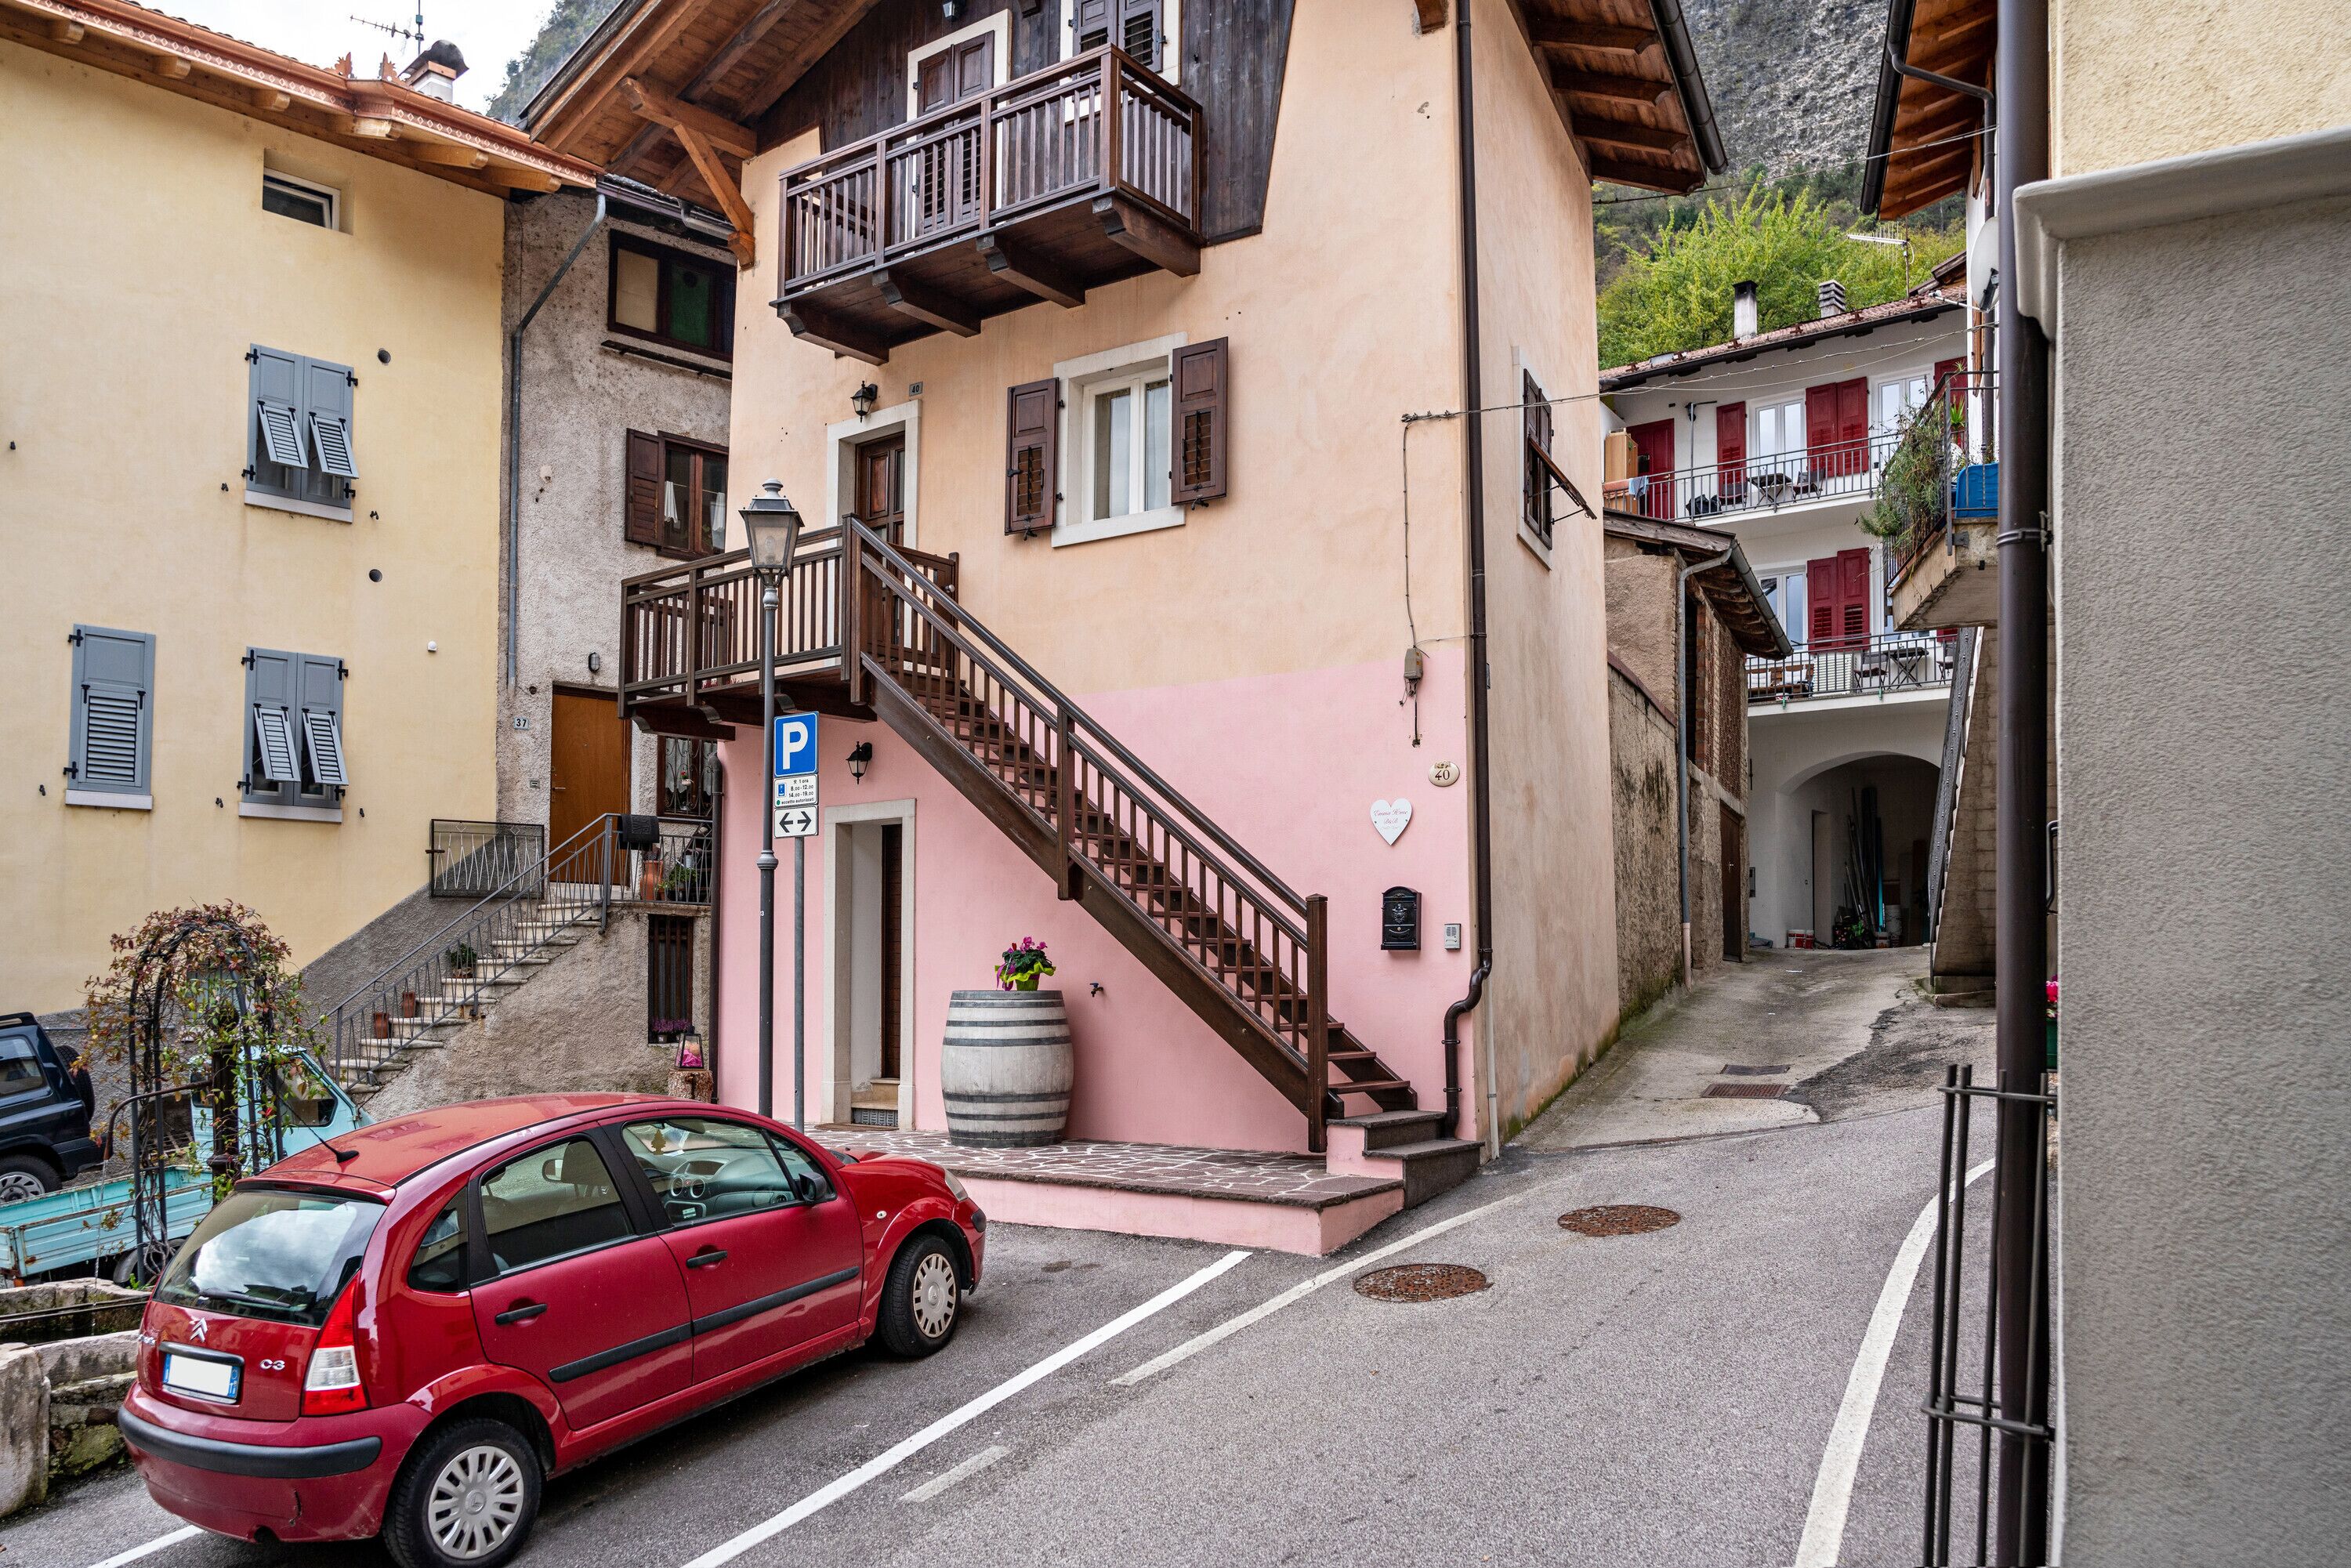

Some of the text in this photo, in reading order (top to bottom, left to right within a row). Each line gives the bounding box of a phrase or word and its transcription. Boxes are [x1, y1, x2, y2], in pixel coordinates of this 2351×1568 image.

[911, 385, 920, 393] 40
[516, 719, 527, 727] 37
[782, 721, 809, 770] P
[1435, 770, 1450, 780] 40
[260, 1359, 285, 1371] C3
